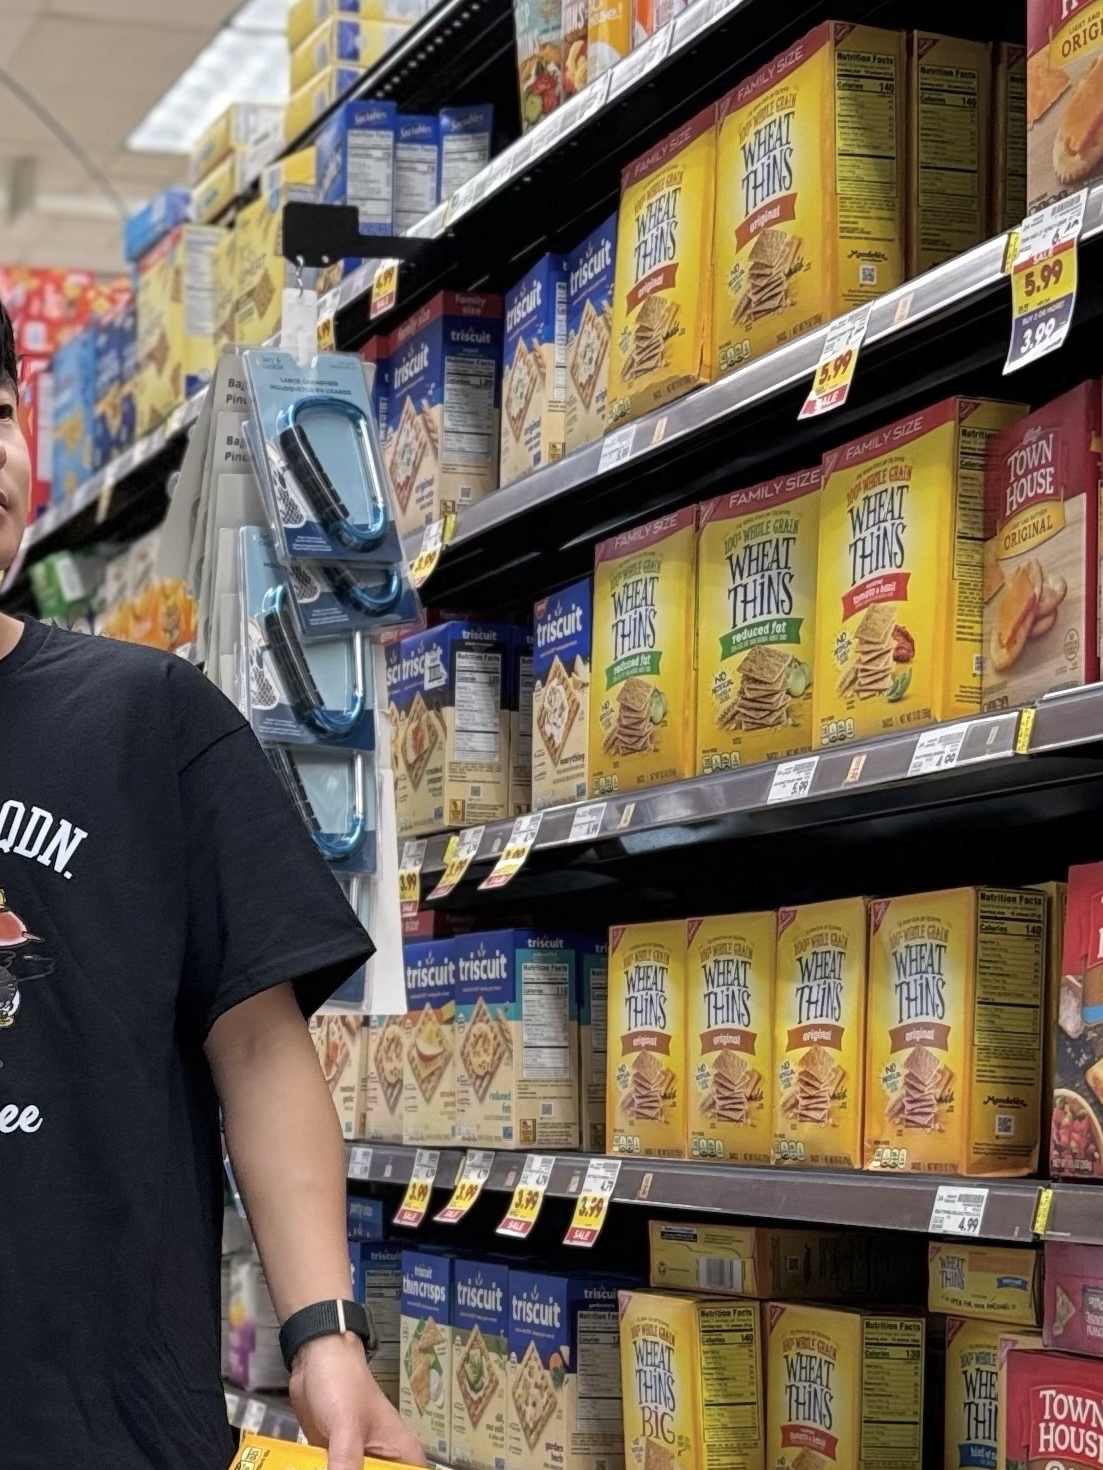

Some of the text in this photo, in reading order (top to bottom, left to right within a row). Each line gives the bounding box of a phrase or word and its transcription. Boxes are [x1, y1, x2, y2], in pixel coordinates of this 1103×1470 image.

[776, 45, 804, 75] SIZE
[740, 111, 796, 171] WHEAT
[635, 186, 682, 244] WHEAT
[568, 239, 613, 292] triscuit
[1024, 258, 1064, 297] 5.99
[504, 279, 543, 332] triscuit
[450, 330, 491, 344] triscuit
[1020, 317, 1057, 355] 3.99
[393, 345, 429, 390] triscuit
[818, 350, 853, 386] 5.99
[846, 416, 924, 461] FAMILY SIZE
[1006, 432, 1054, 484] TOWN
[729, 468, 821, 509] FAMILY SIZE
[1005, 466, 1055, 517] HOUSE
[848, 484, 909, 540] WHEAT
[614, 513, 678, 549] FAMILY SIZE
[1003, 516, 1053, 551] ORIGINAL
[725, 537, 797, 585] WHEAT
[611, 576, 659, 621] WHEAT
[461, 629, 497, 641] triscuit
[536, 603, 583, 649] triscuit
[731, 620, 787, 646] reduced fat
[980, 891, 1042, 905] Nutrition Facts
[527, 936, 564, 949] triscuit
[406, 957, 455, 990] triscuit
[458, 949, 507, 982] triscuit
[701, 958, 752, 990] WHEAT
[795, 949, 846, 985] WHEAT
[891, 942, 947, 979] WHEAT
[624, 964, 669, 996] WHEAT
[408, 1183, 429, 1203] 3.99
[455, 1183, 479, 1203] 3.99
[513, 1188, 540, 1212] 3.99
[578, 1195, 605, 1220] 3.99
[507, 1220, 524, 1233] SALE
[572, 1228, 592, 1241] SALE
[958, 1216, 980, 1233] 4.99
[939, 1255, 966, 1272] WHEAT
[402, 1276, 446, 1304] thin crisps
[456, 1278, 503, 1313] triscuit
[583, 1288, 617, 1301] triscui
[511, 1292, 561, 1329] triscuit
[700, 1308, 753, 1318] Nutrition Facts
[864, 1321, 921, 1333] Nutrition Facts
[632, 1338, 676, 1377] WHEAT
[905, 1349, 921, 1359] 130
[783, 1353, 835, 1391] WHEAT
[962, 1367, 998, 1401] WHE
[1039, 1389, 1103, 1432] TOWN
